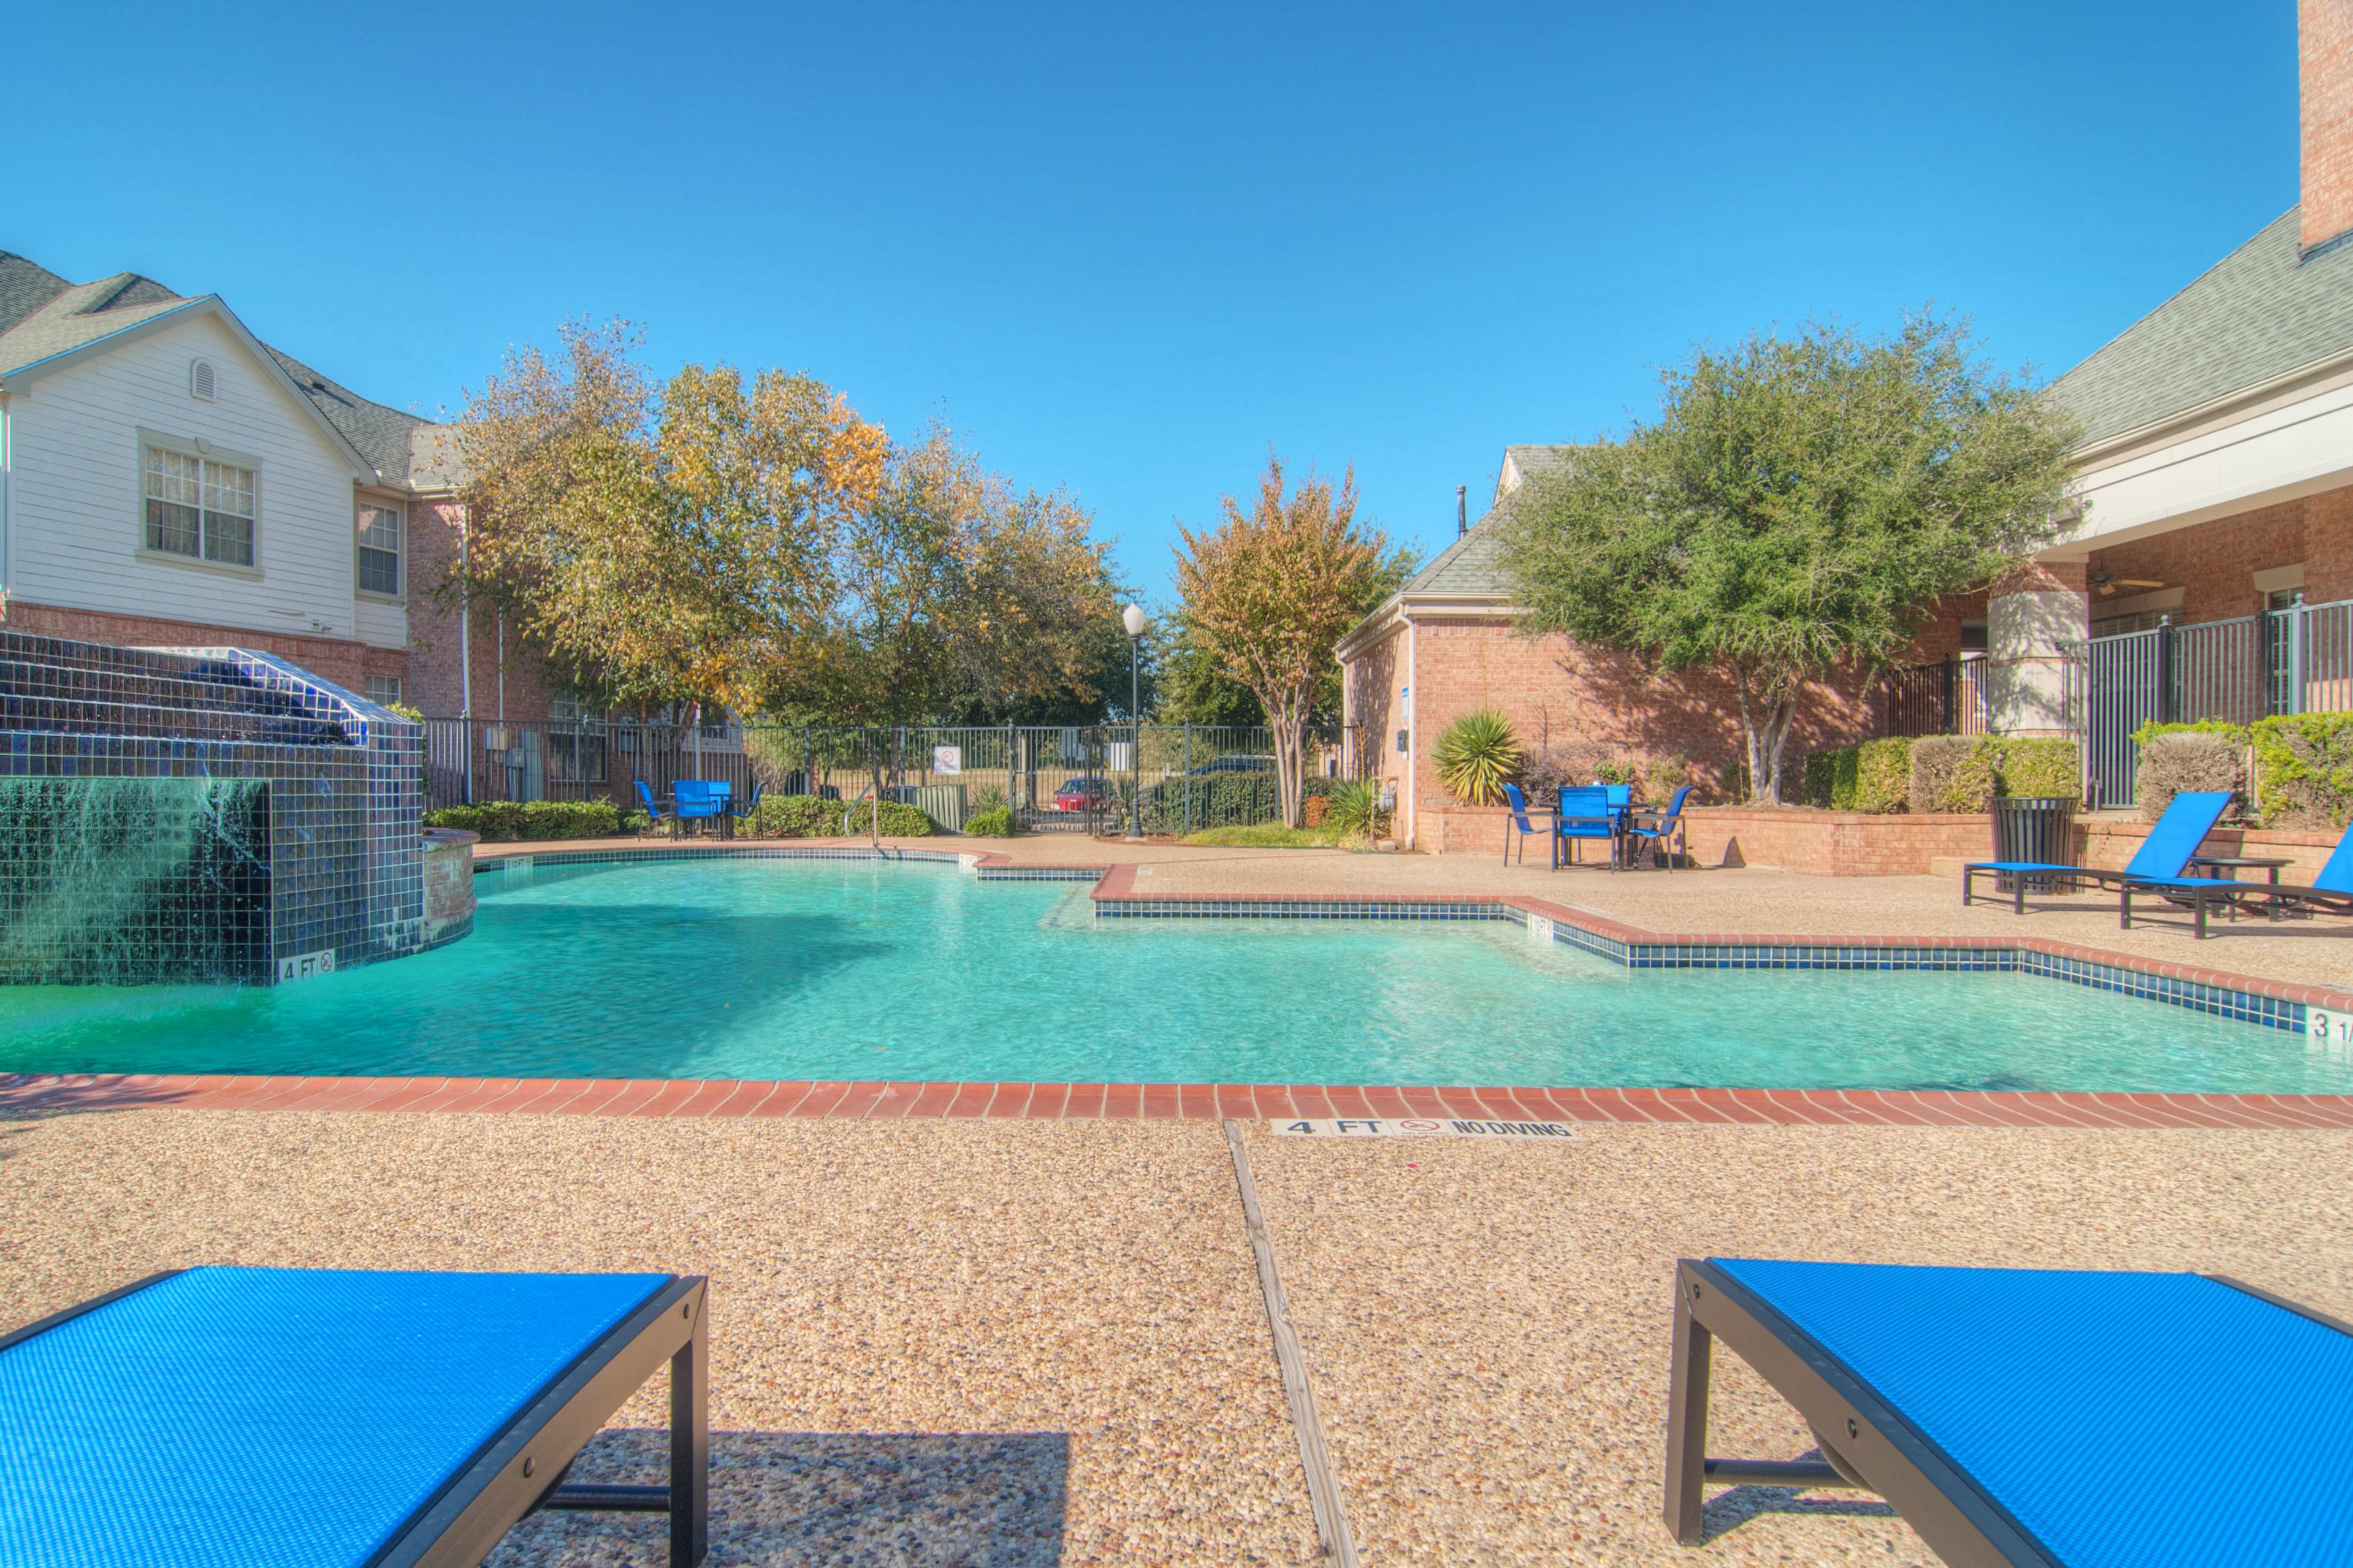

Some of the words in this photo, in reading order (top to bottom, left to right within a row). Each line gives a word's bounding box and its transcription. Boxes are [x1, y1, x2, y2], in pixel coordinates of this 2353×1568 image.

[285, 962, 294, 978] 4
[302, 957, 315, 980] FT
[2314, 1013, 2327, 1038] 3
[1287, 1122, 1316, 1133] 4
[1337, 1121, 1382, 1133] FT
[1451, 1121, 1486, 1134] NO
[1485, 1122, 1573, 1136] DIVING
